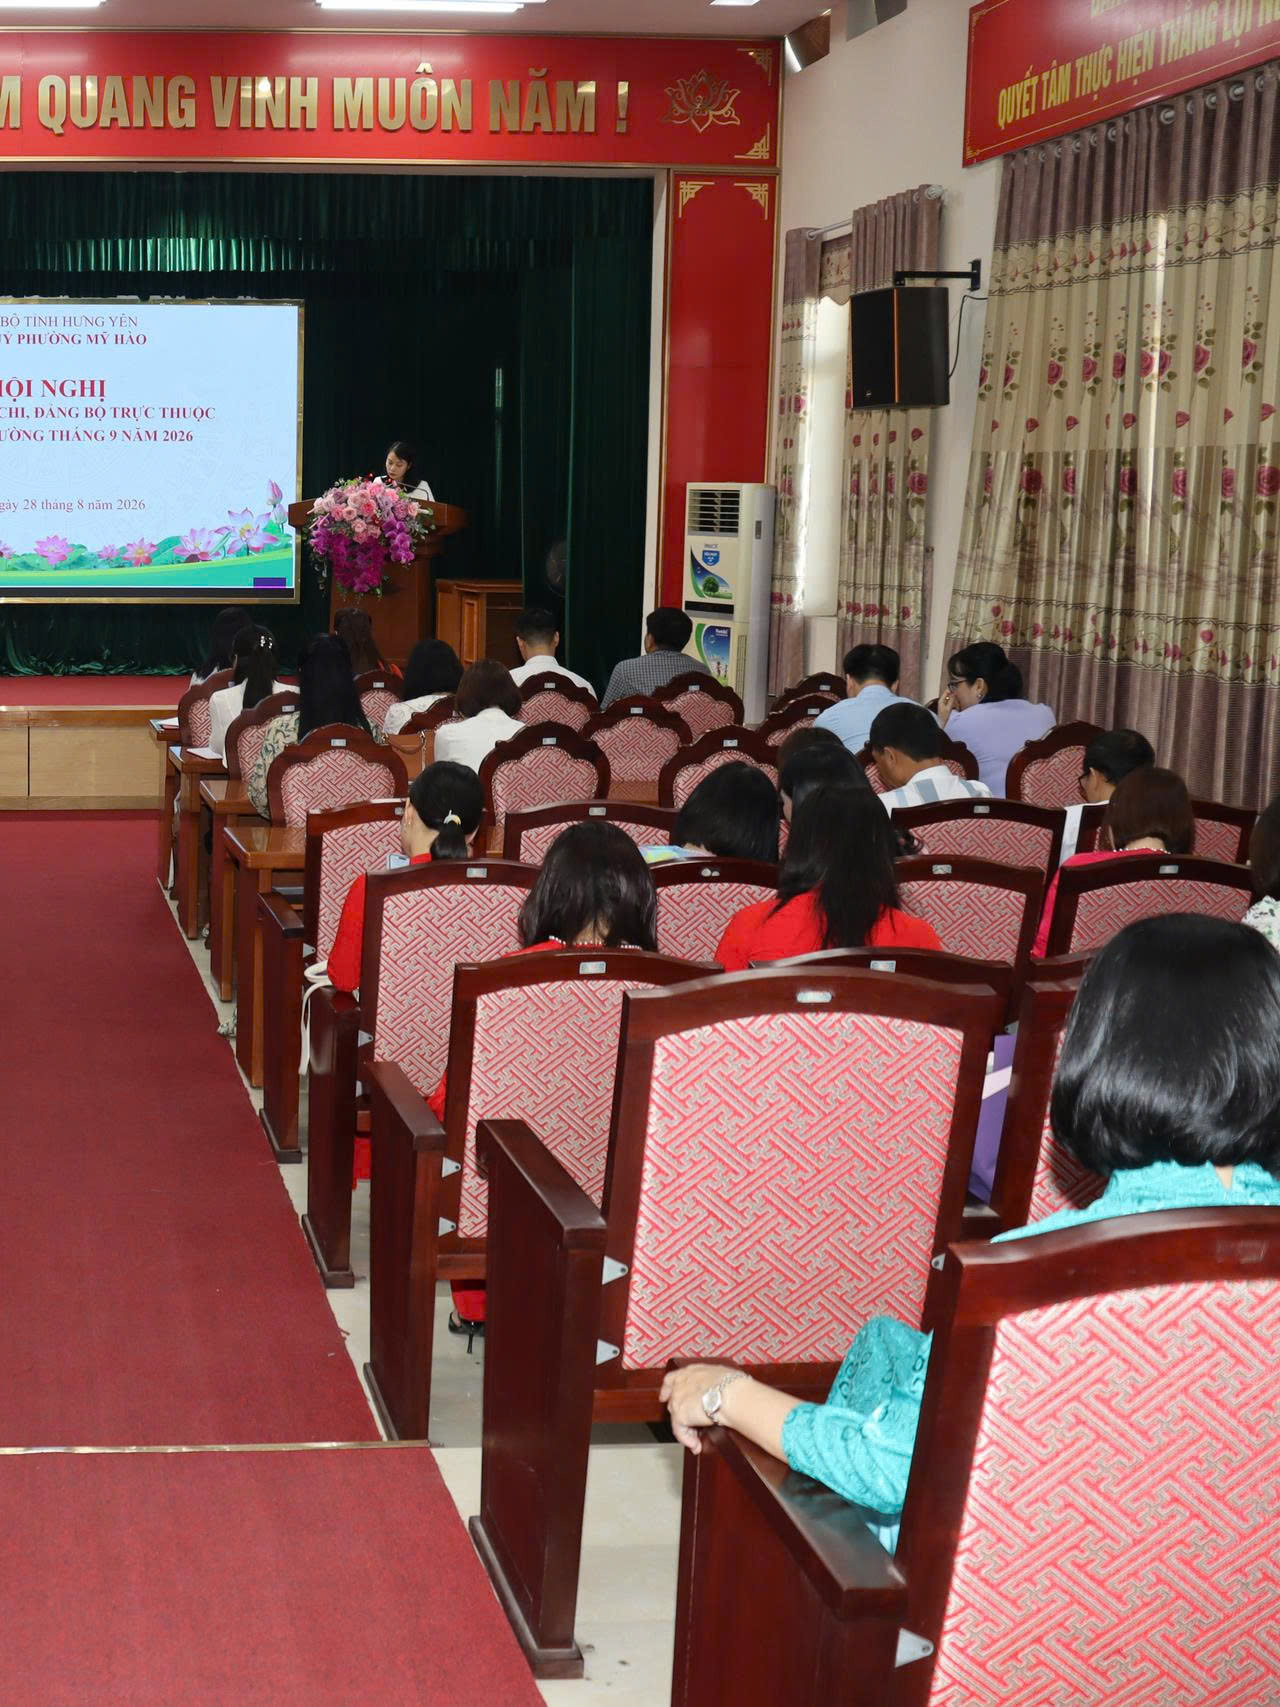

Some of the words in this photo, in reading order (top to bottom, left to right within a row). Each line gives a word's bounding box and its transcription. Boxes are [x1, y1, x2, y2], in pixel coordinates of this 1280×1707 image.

[997, 65, 1039, 130] QUYẾT
[1042, 60, 1071, 110] TÂM
[1074, 44, 1113, 100] THỰC
[1116, 24, 1155, 85] HIỆN
[38, 75, 196, 135] QUANG
[210, 75, 318, 129] VINH
[333, 62, 472, 132] MUÔN
[489, 69, 596, 133] NĂM
[616, 80, 628, 133] !
[0, 313, 20, 329] BỘ
[63, 314, 105, 328] HƯNG
[109, 313, 138, 328] YÊN
[18, 330, 81, 345] PHƯỜNG
[86, 331, 110, 345] MỸ
[115, 330, 147, 345] HÀO
[41, 379, 106, 402] NGHỊ
[35, 404, 79, 419] ĐẢNG
[84, 404, 106, 422] BỘ
[110, 405, 155, 422] TRỰC
[159, 405, 216, 422] THUỘC
[49, 426, 105, 442] THÁNG
[109, 430, 117, 442] 9
[121, 427, 158, 442] NĂM
[162, 430, 193, 442] 2026
[23, 499, 37, 510] 28
[41, 498, 73, 513] tháng
[77, 499, 84, 510] 8
[88, 499, 113, 510] năm
[117, 499, 146, 510] 2026
